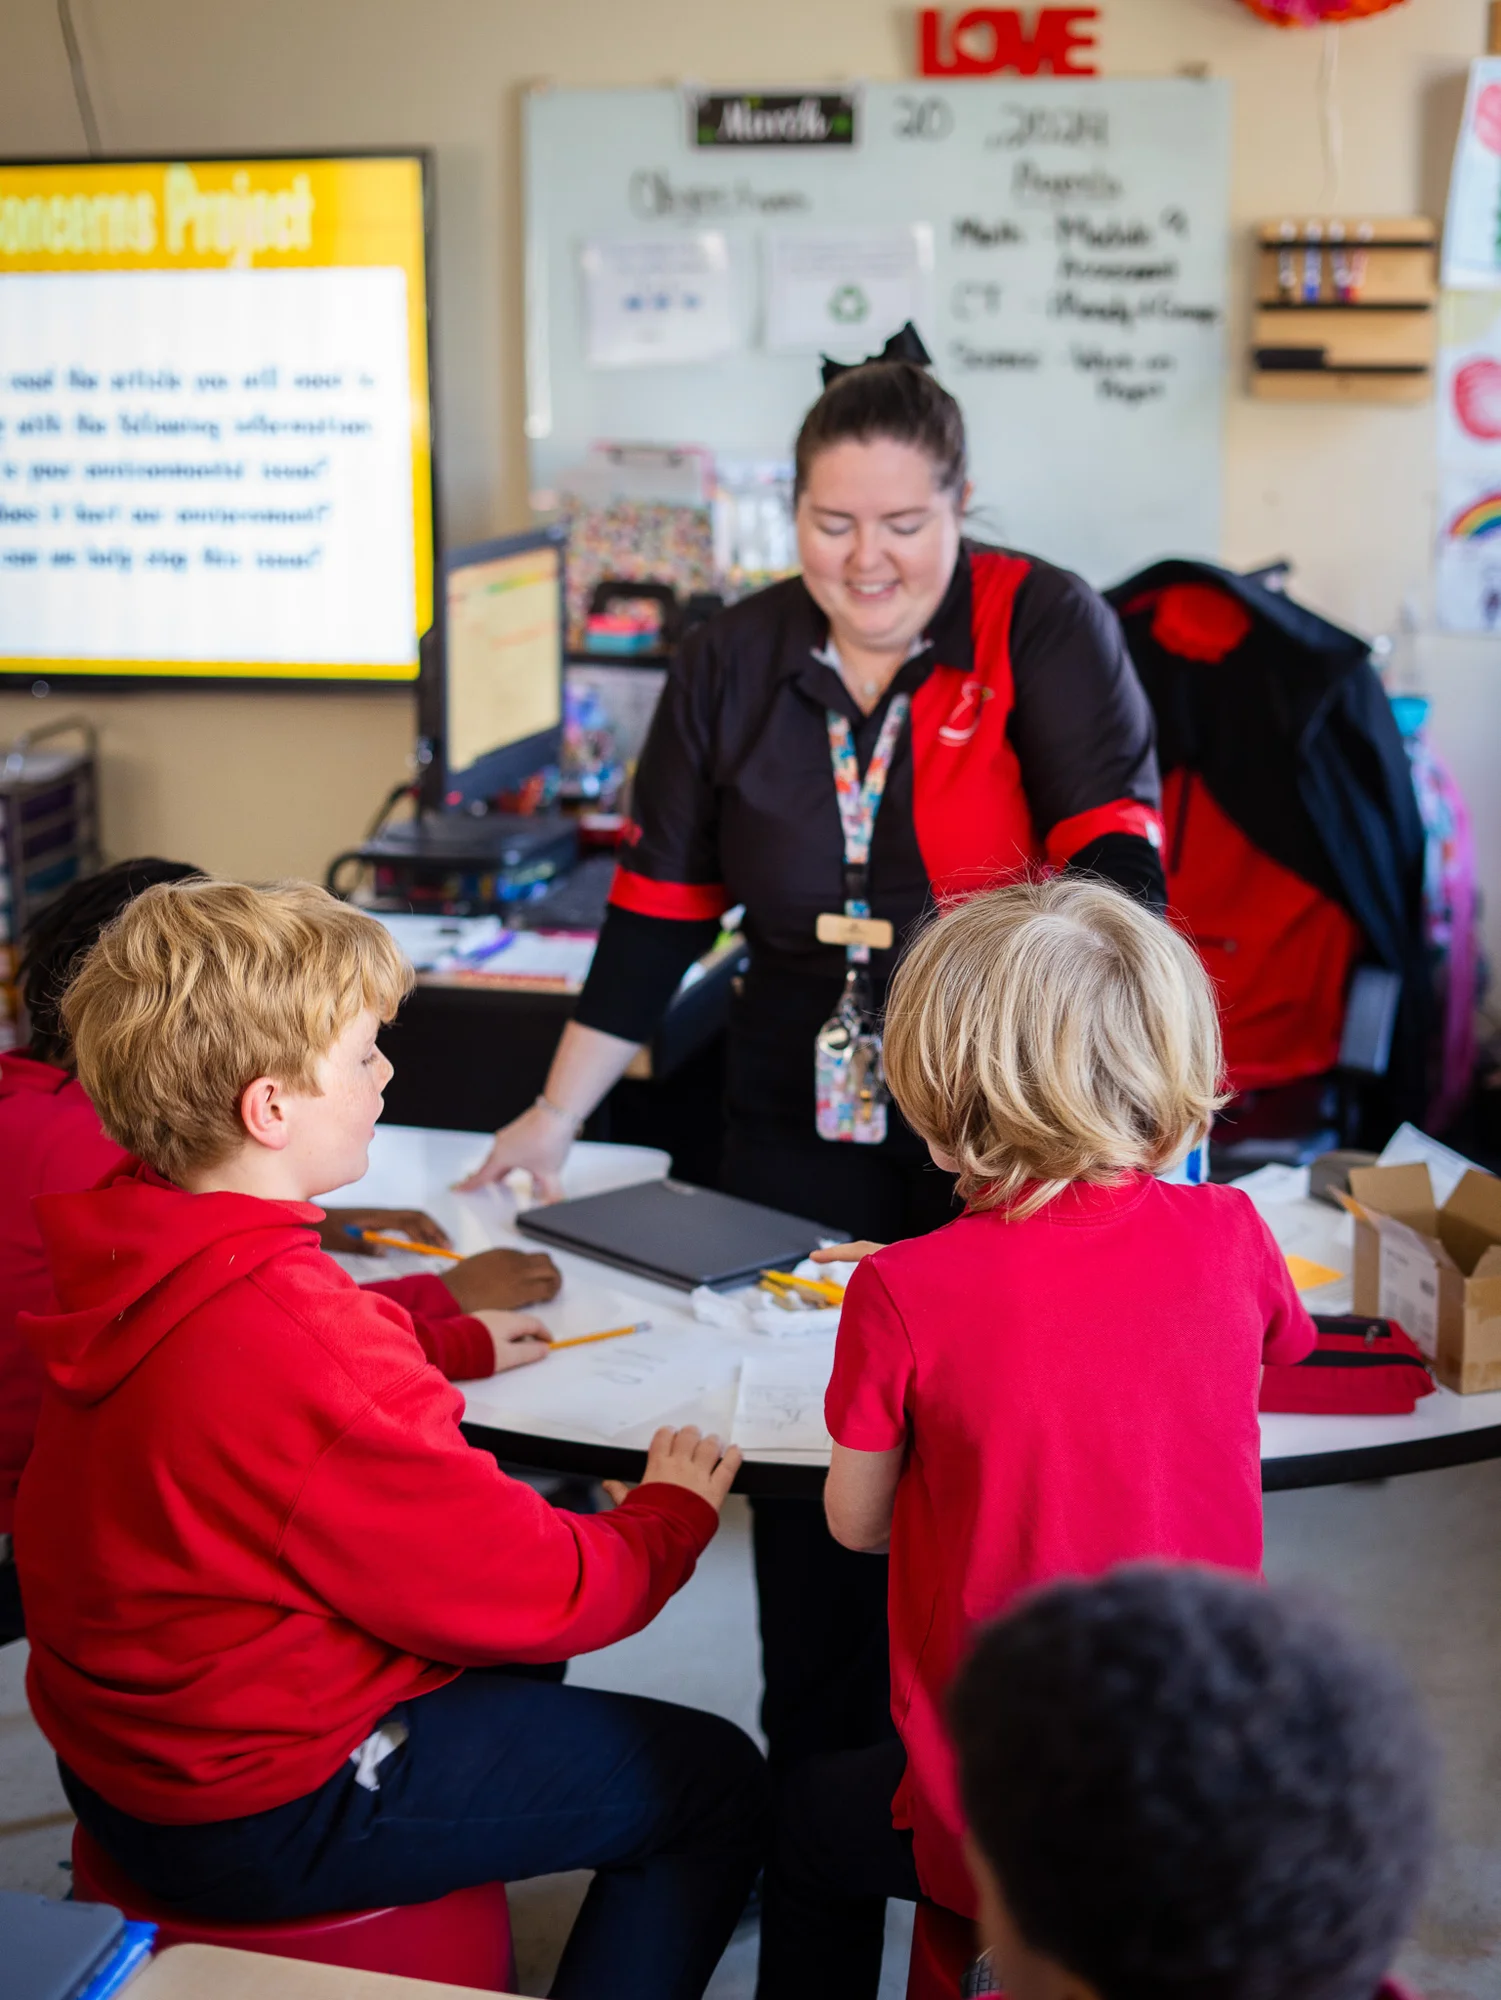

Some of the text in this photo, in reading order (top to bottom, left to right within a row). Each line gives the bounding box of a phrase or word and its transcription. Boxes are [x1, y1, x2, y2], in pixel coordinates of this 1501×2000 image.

[919, 8, 1098, 78] LOVE
[716, 97, 831, 141] March
[894, 96, 951, 140] 20
[0, 163, 314, 268] oncerns Project
